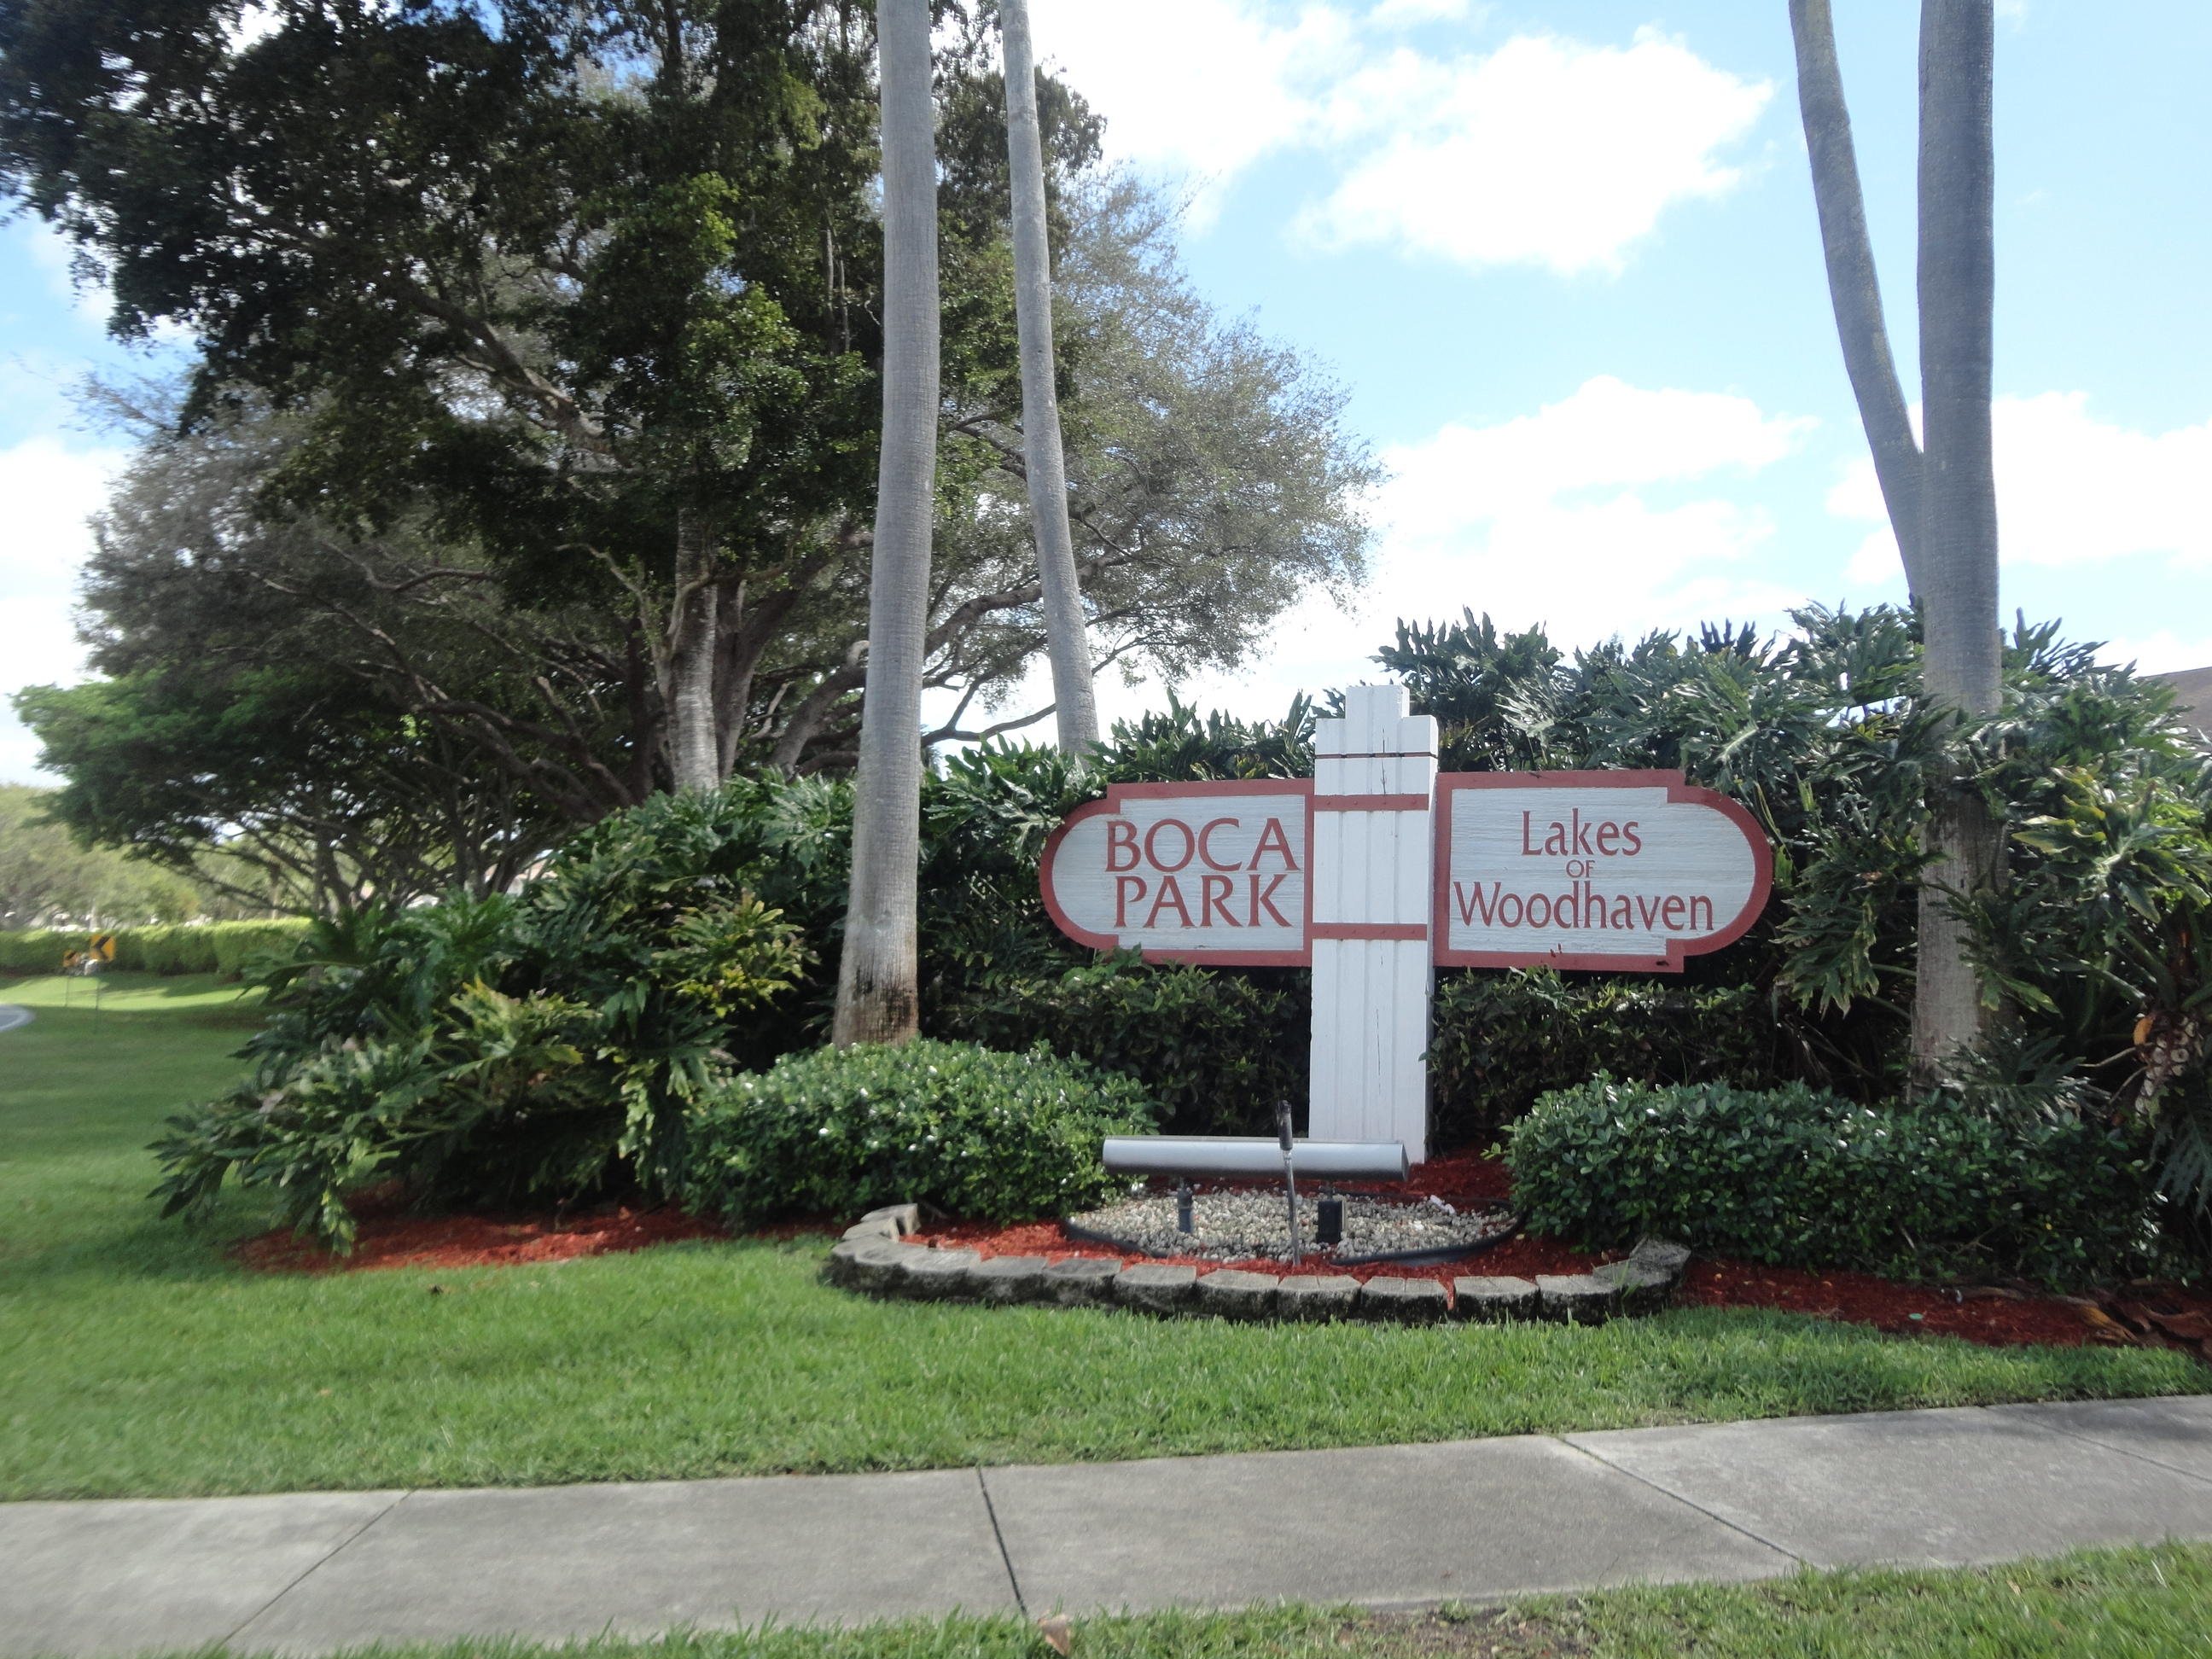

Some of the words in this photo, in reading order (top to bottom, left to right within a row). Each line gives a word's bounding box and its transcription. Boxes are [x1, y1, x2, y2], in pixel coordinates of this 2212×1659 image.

[1105, 817, 1300, 872] BOCA
[1522, 807, 1641, 856] Lakes
[1566, 859, 1594, 878] OF
[1114, 873, 1293, 928] PARK
[1453, 881, 1714, 931] Woodhaven
